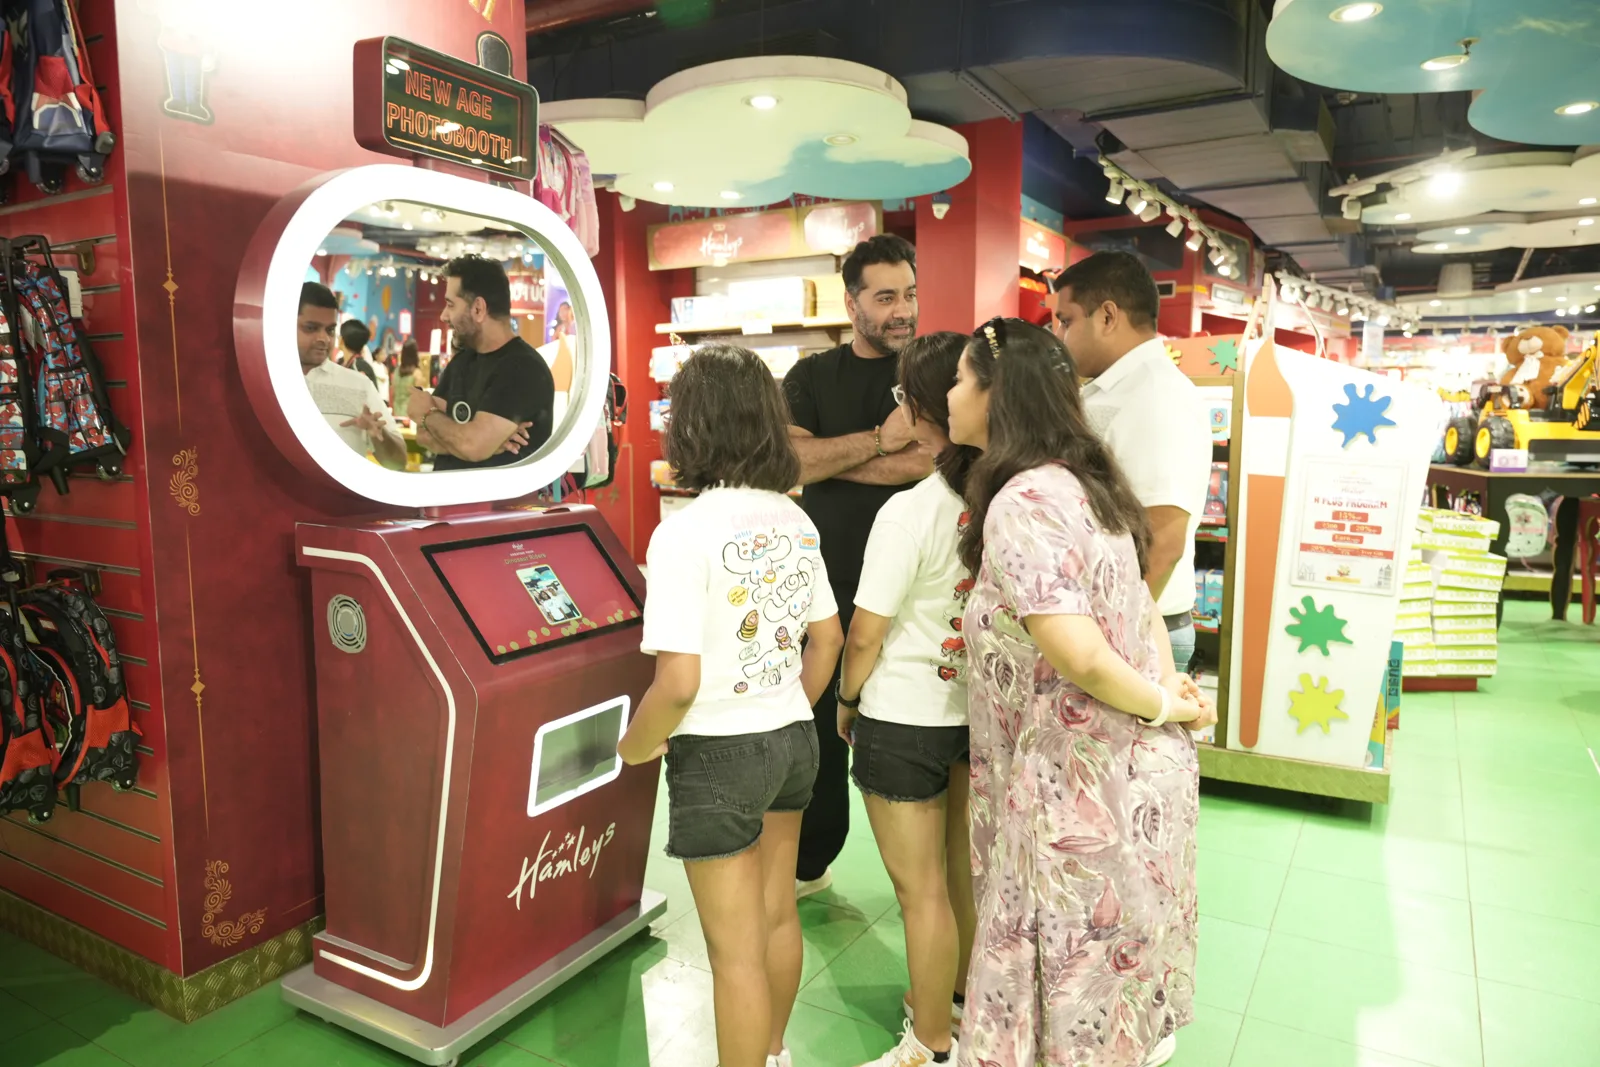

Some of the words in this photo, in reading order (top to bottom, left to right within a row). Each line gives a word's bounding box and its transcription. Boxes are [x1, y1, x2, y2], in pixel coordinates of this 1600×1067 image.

[405, 69, 452, 107] NEW
[456, 87, 493, 120] AGE
[386, 102, 512, 160] PHOTOBOOTH
[1322, 499, 1343, 507] PLUS
[507, 822, 616, 910] Hamleys
